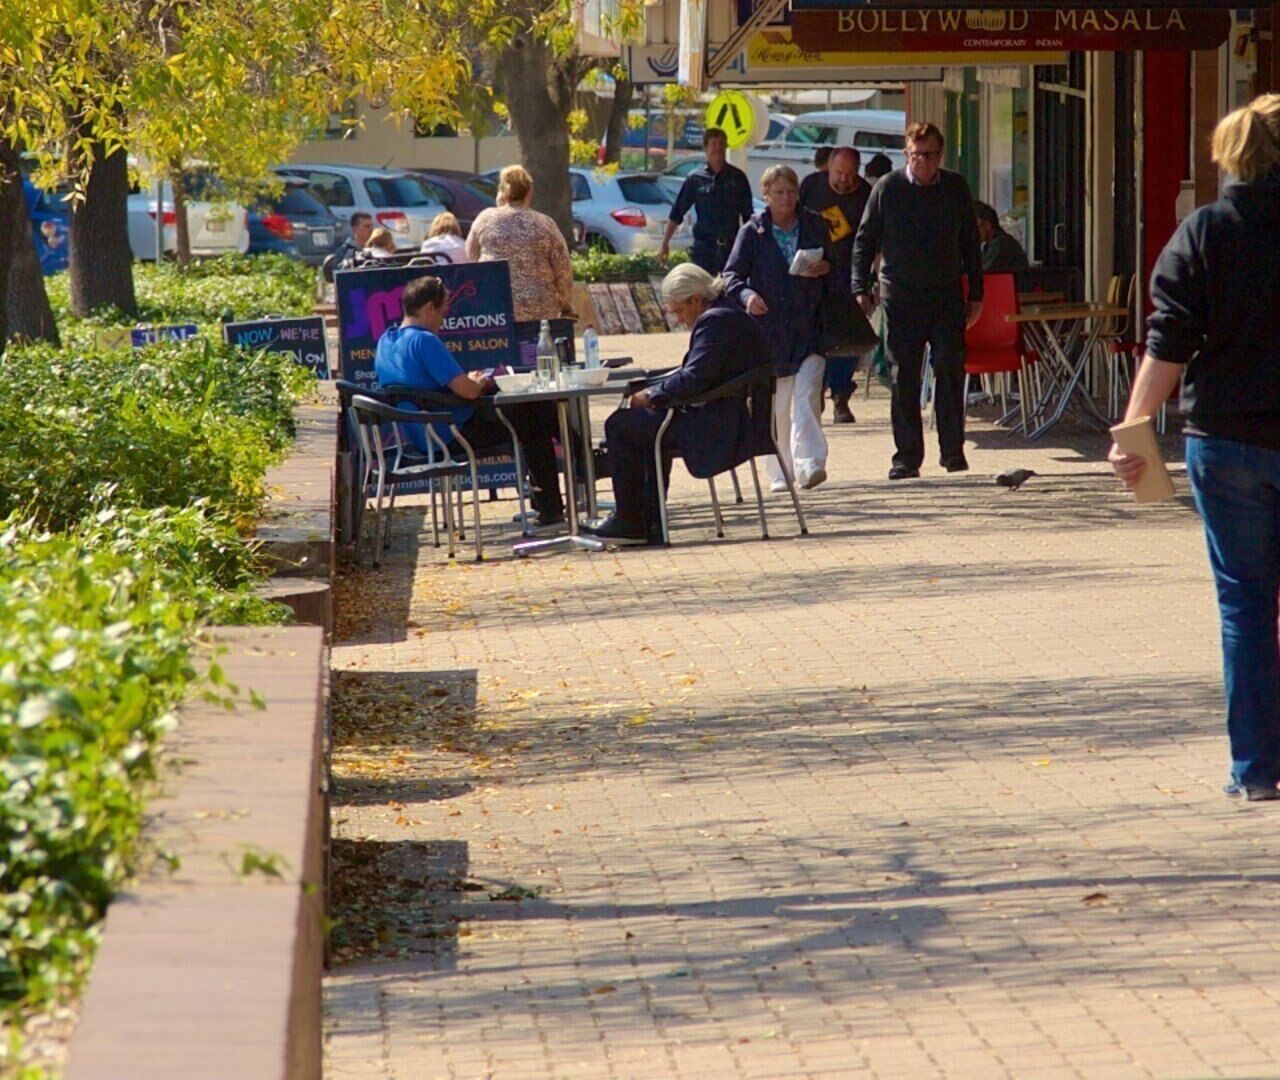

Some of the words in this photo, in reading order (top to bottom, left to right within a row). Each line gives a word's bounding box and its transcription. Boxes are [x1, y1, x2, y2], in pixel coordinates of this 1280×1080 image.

[1054, 8, 1186, 33] MASALA
[963, 38, 1027, 48] CONTEMPORARY
[1035, 39, 1063, 48] INDIAN
[440, 313, 507, 331] REATIONS
[468, 338, 509, 351] SALON
